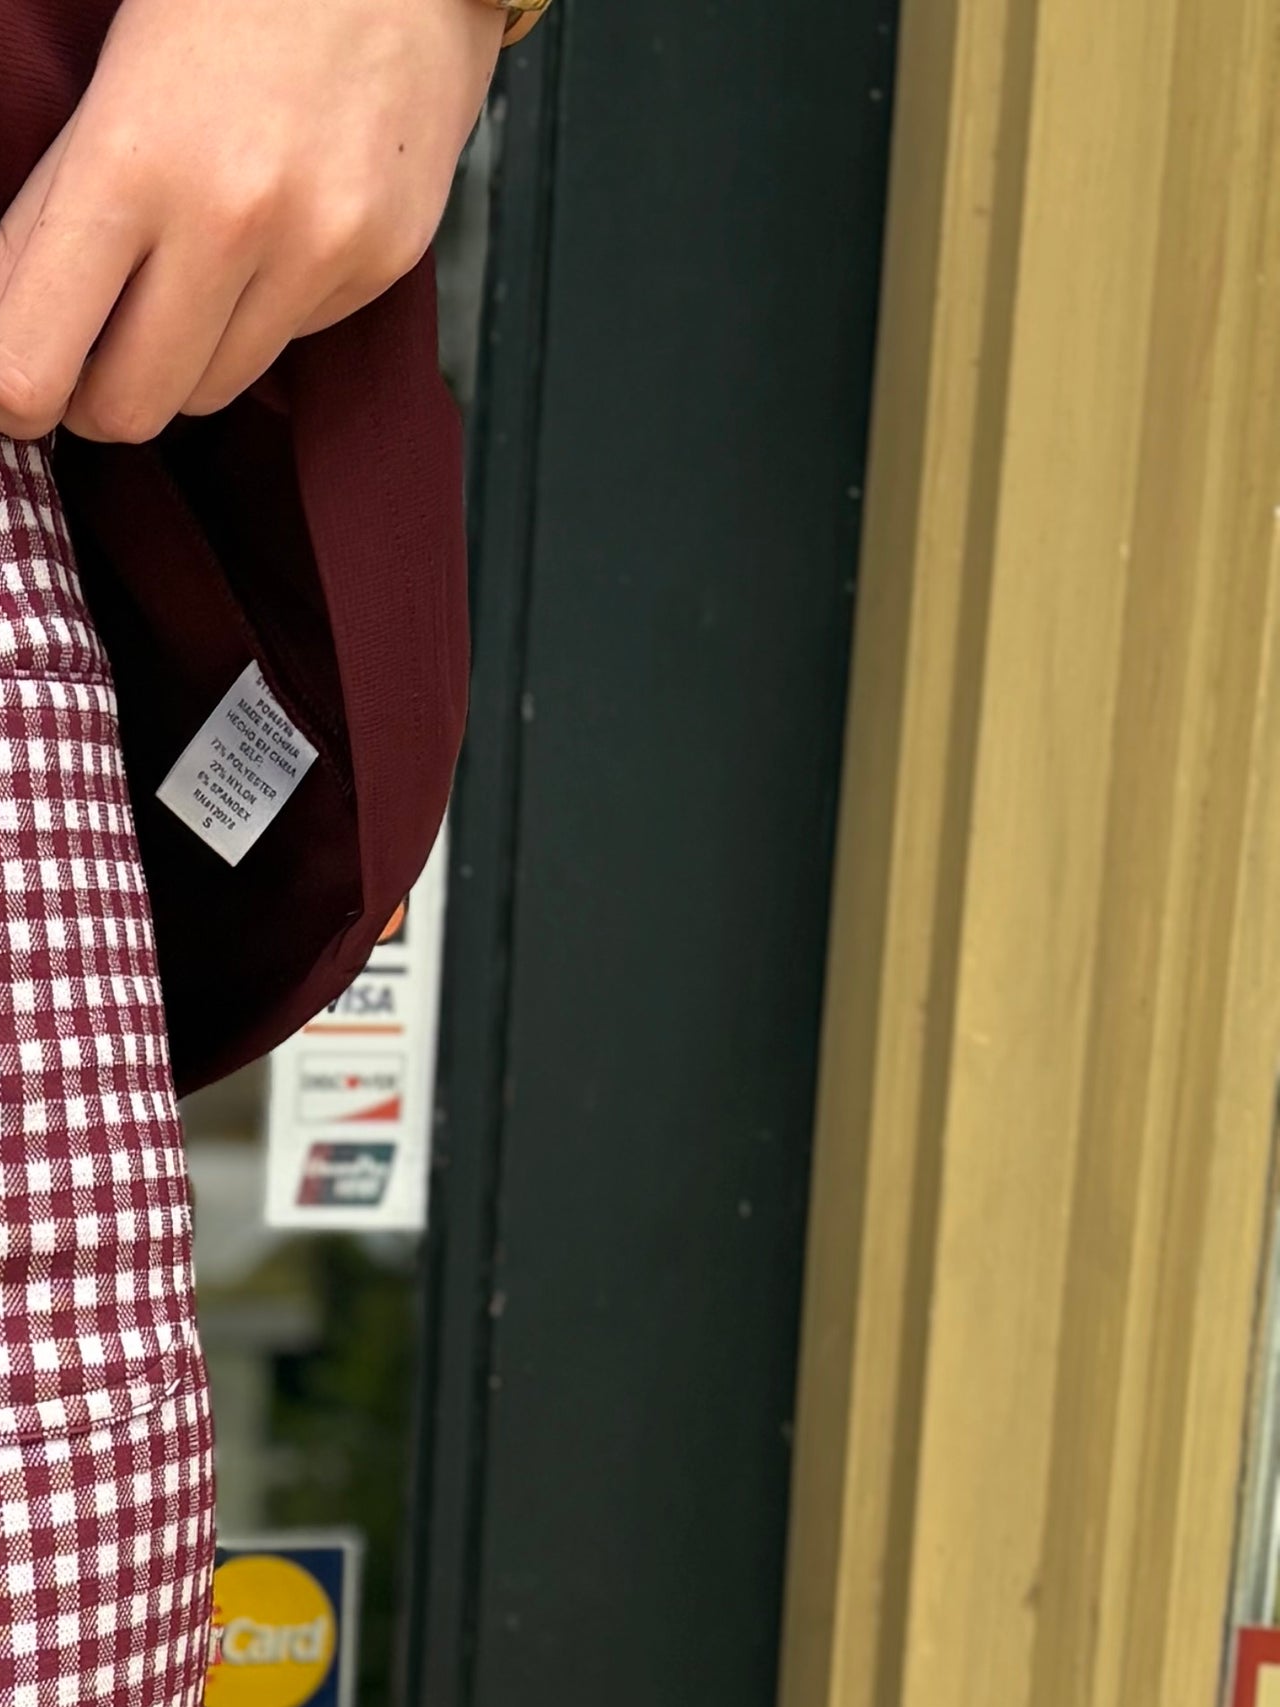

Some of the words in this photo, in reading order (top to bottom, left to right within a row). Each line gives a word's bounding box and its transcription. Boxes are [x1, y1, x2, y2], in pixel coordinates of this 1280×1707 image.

[225, 708, 257, 742] HECHO
[254, 737, 272, 756] EN
[268, 750, 297, 779] CHINA
[236, 698, 264, 727] MADE
[271, 730, 301, 760] CHINA
[209, 759, 227, 780] 22%
[225, 773, 258, 806] NYLON
[225, 751, 278, 802] POLYESTER
[201, 816, 214, 830] S
[209, 781, 252, 823] SPANDEX
